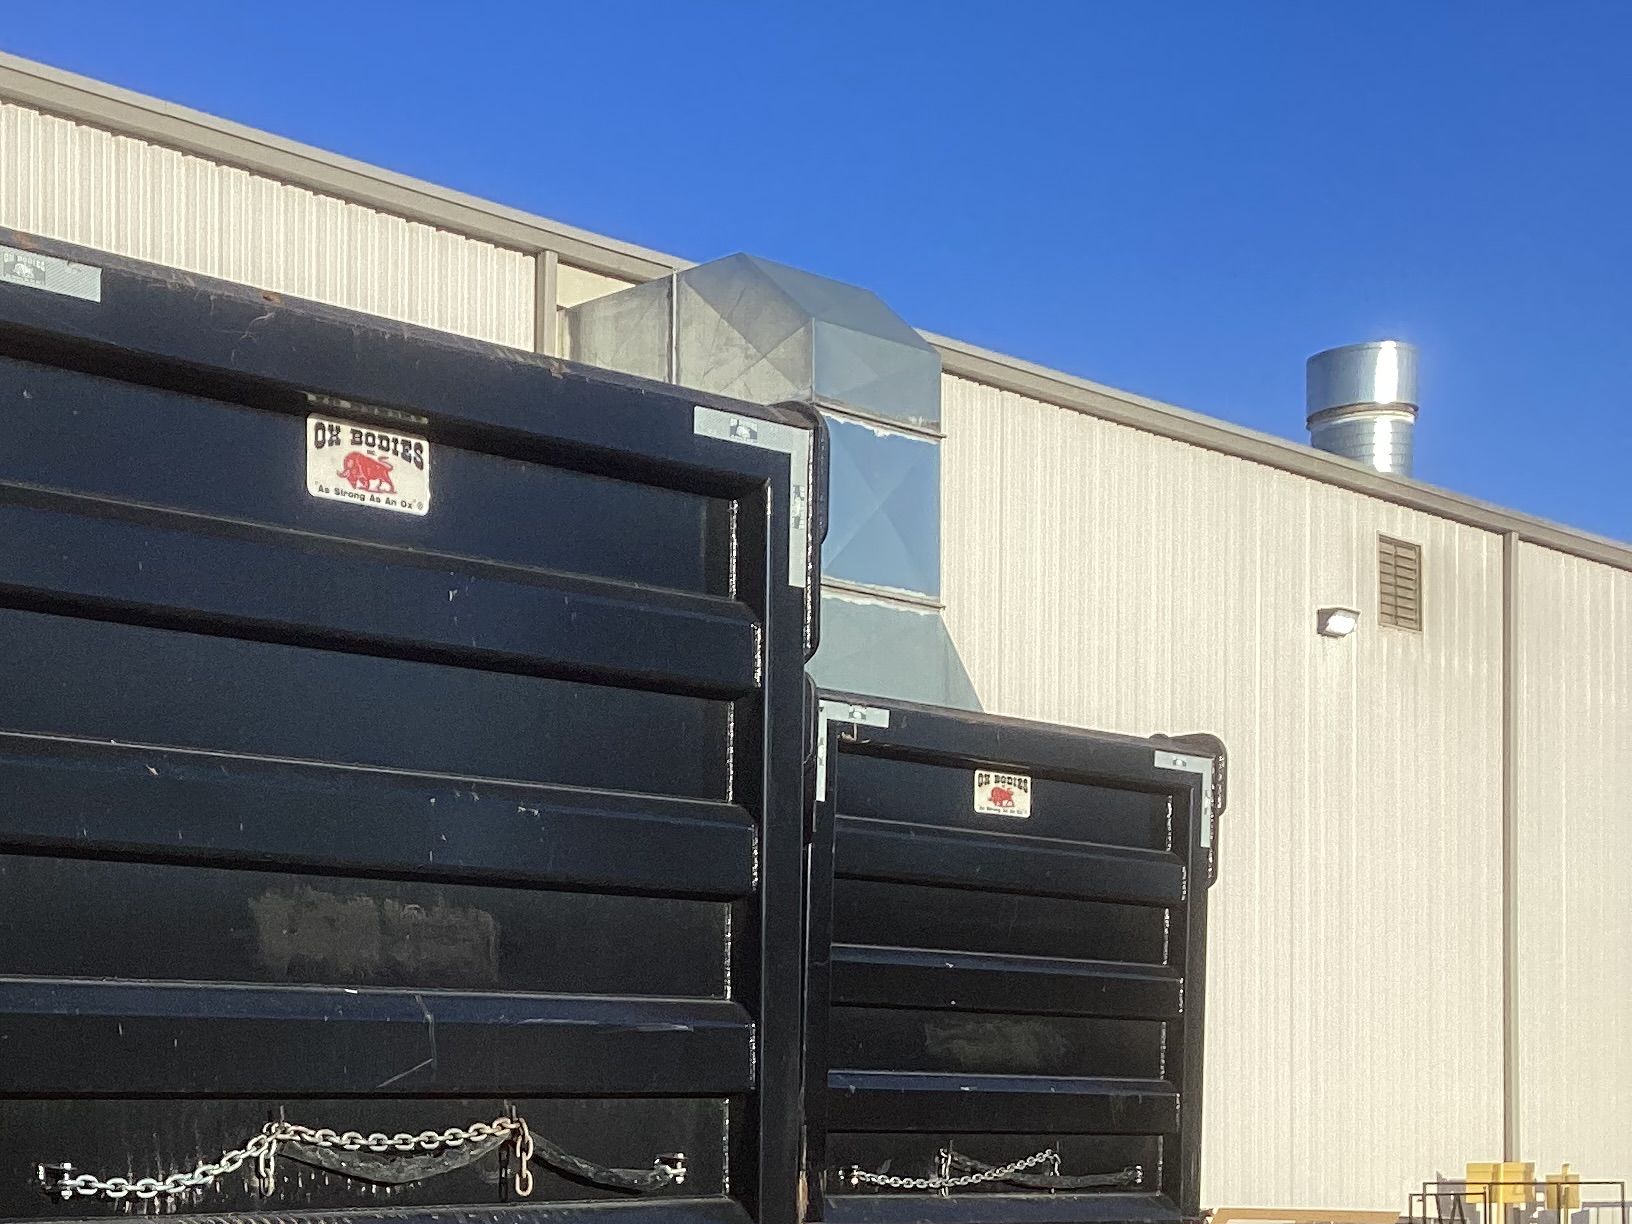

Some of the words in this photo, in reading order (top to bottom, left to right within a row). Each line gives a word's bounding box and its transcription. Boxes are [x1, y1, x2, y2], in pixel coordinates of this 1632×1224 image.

[314, 422, 341, 449] OX
[350, 427, 424, 471] BODIES
[334, 486, 366, 502] Strong
[369, 494, 382, 504] As
[385, 497, 397, 507] An
